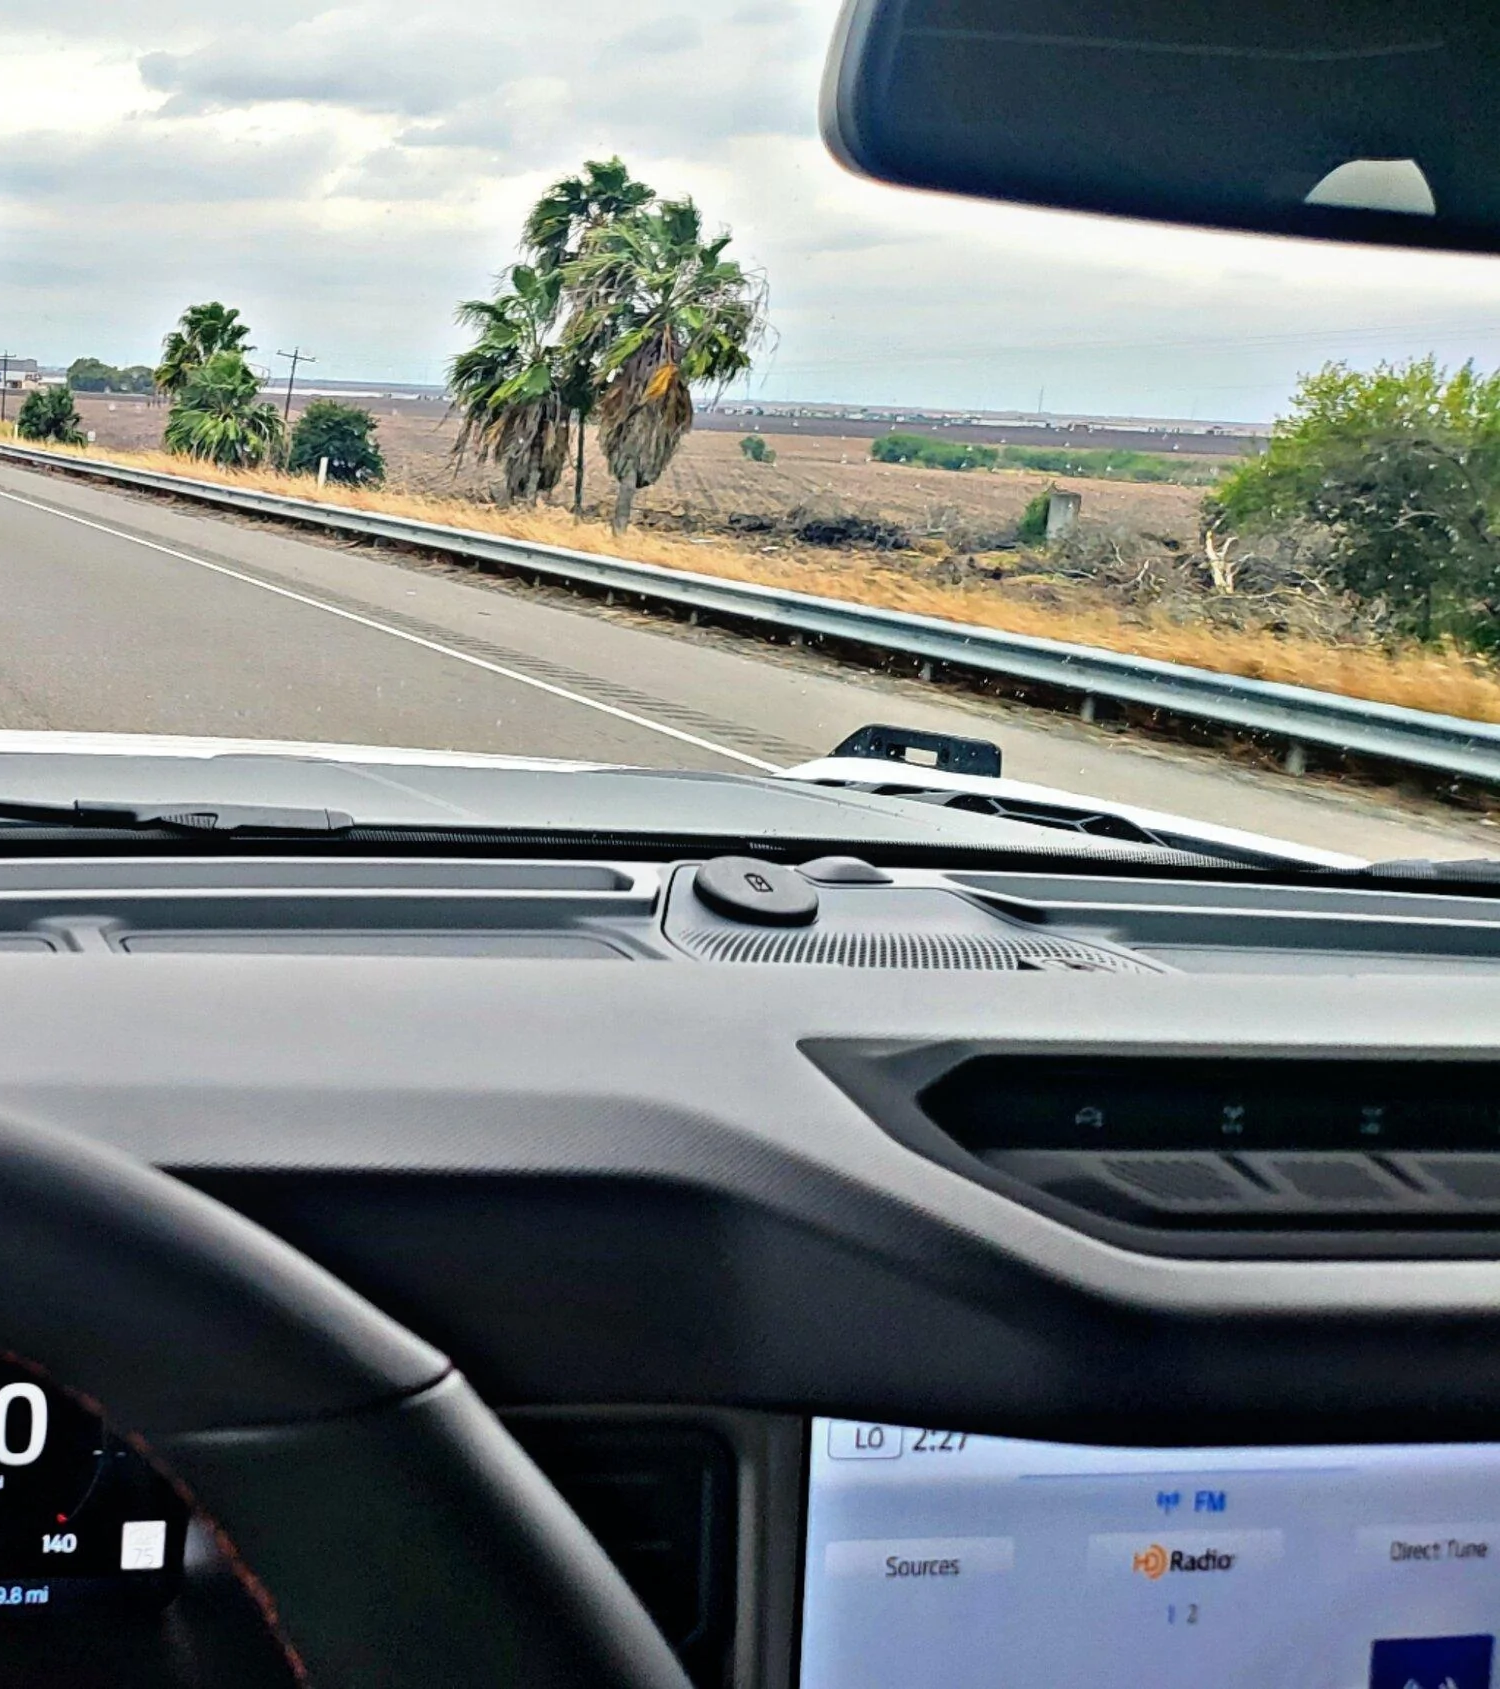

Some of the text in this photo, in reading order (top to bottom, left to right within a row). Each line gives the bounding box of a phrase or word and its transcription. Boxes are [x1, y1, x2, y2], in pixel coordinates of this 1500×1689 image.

[1194, 1490, 1227, 1513] FM
[41, 1533, 79, 1554] 140
[1389, 1539, 1488, 1561] Direct Tune
[884, 1555, 961, 1578] Sources
[25, 1586, 49, 1604] mi
